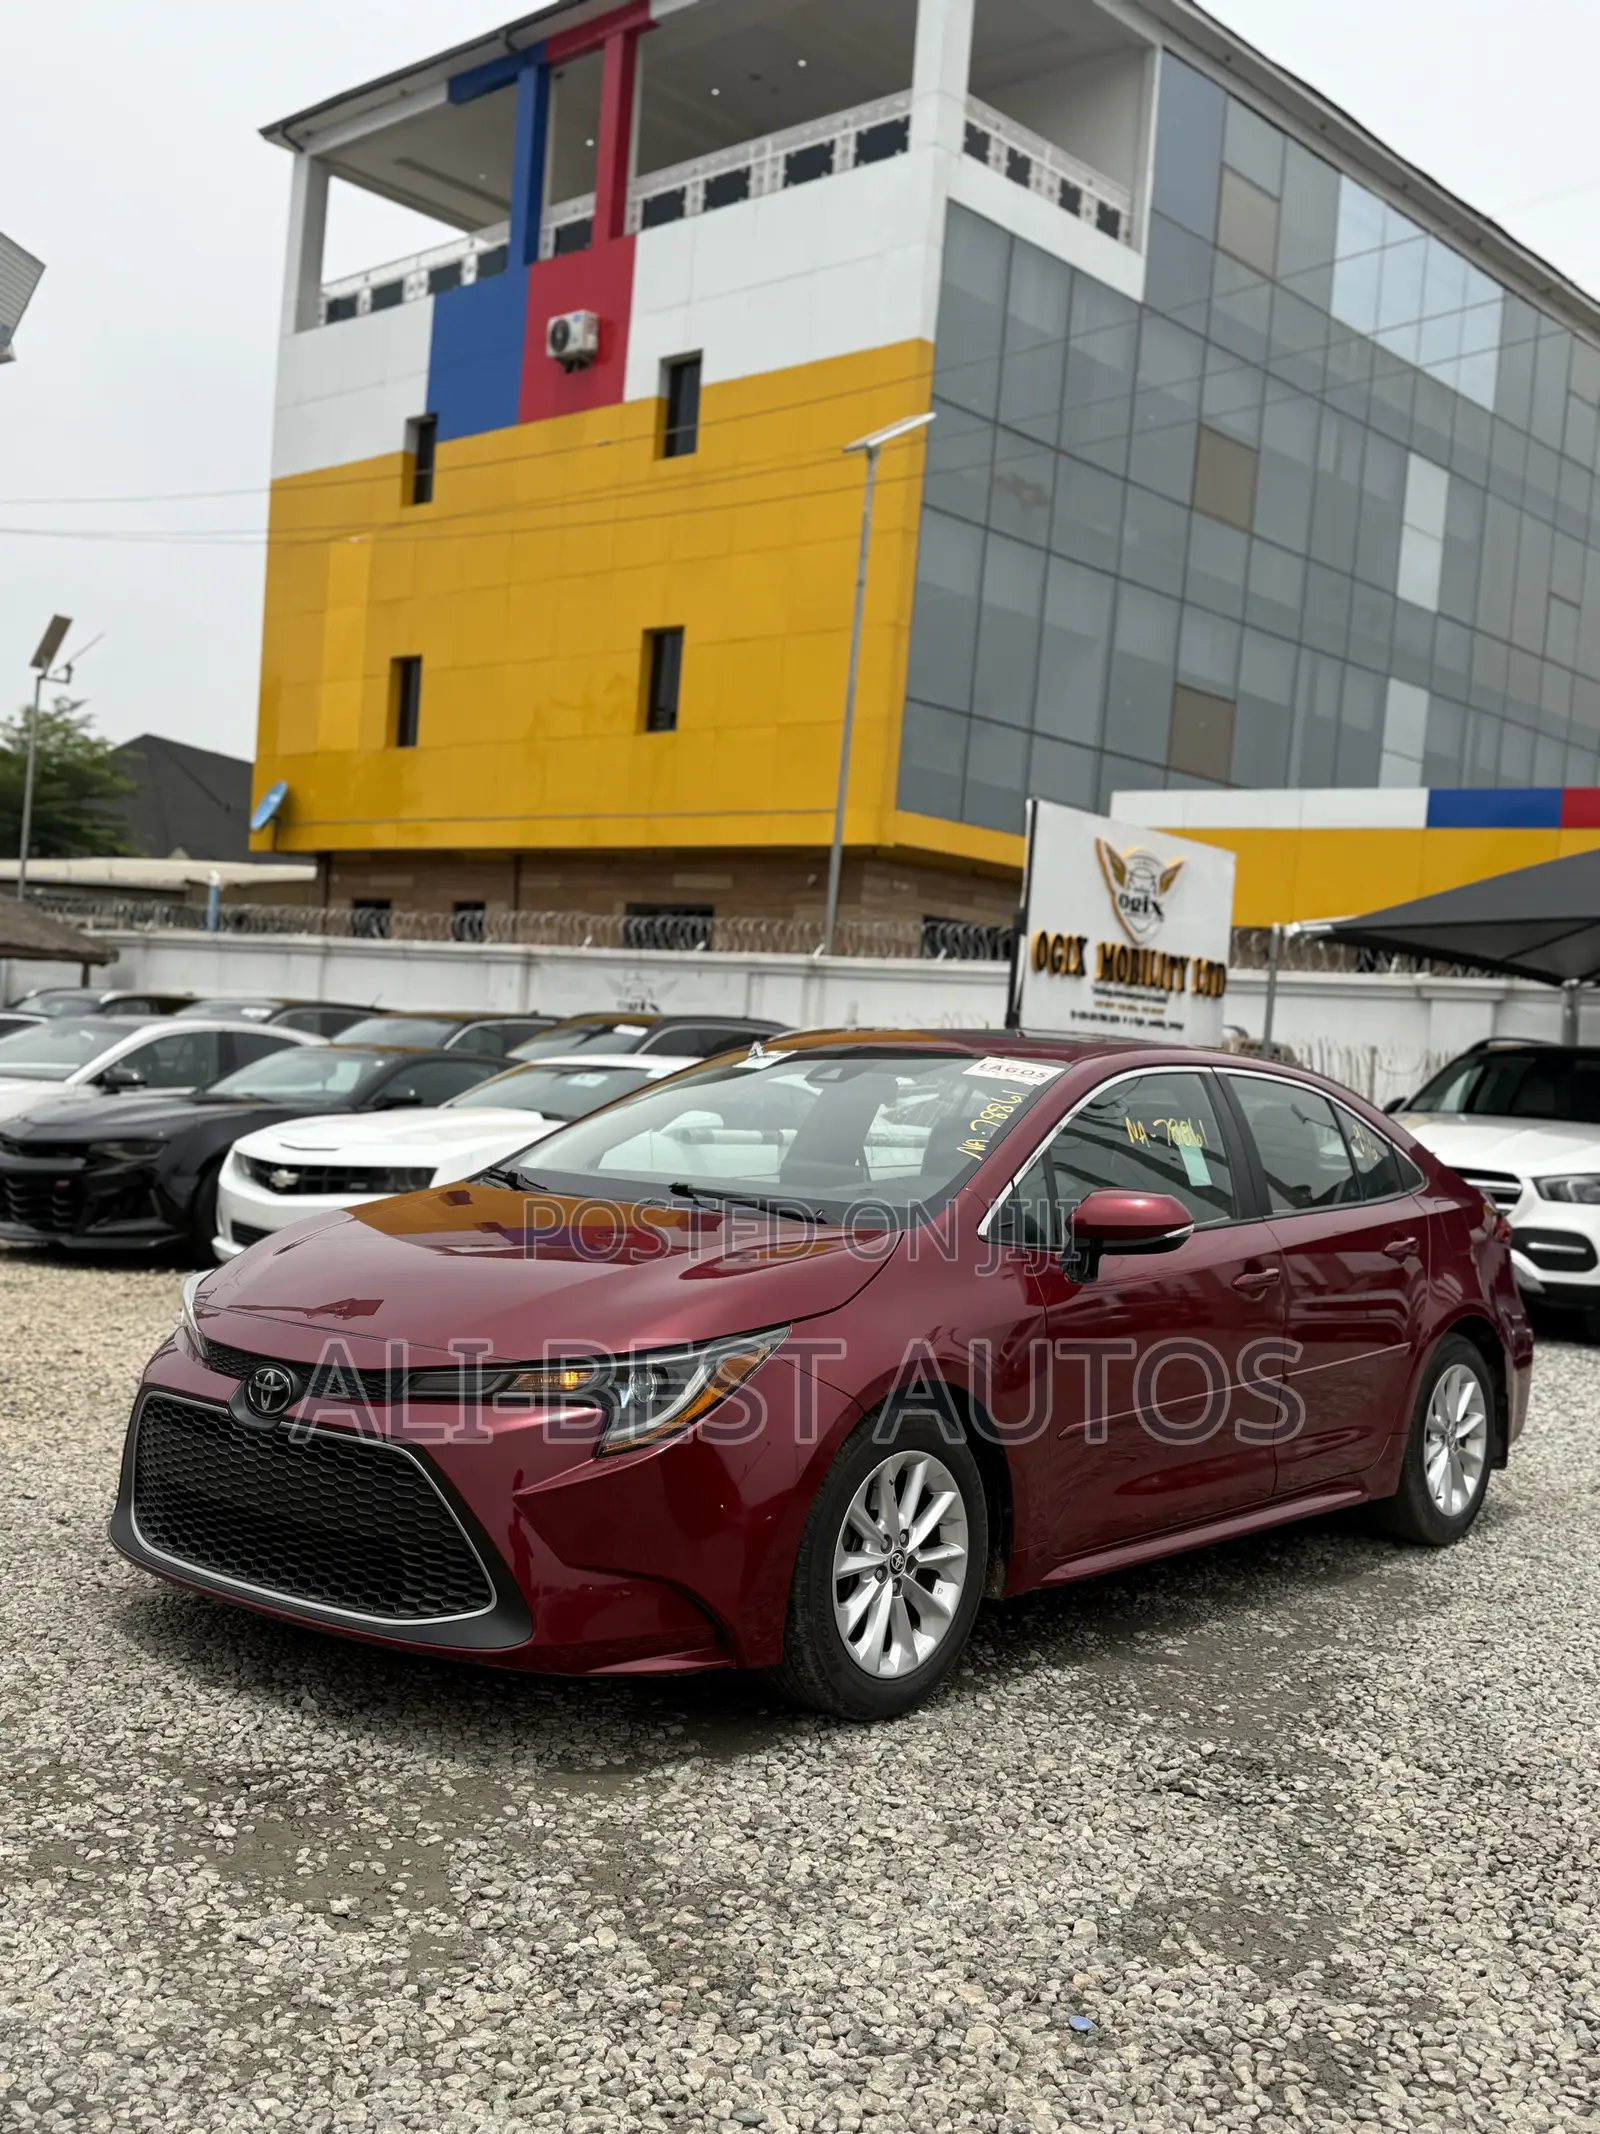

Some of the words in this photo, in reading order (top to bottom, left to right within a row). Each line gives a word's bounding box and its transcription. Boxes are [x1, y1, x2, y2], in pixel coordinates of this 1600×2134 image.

[1031, 930, 1088, 977] OGIX
[1094, 942, 1190, 992] MOBILITY
[1191, 957, 1227, 999] LTD
[979, 1062, 1049, 1079] LAGOS
